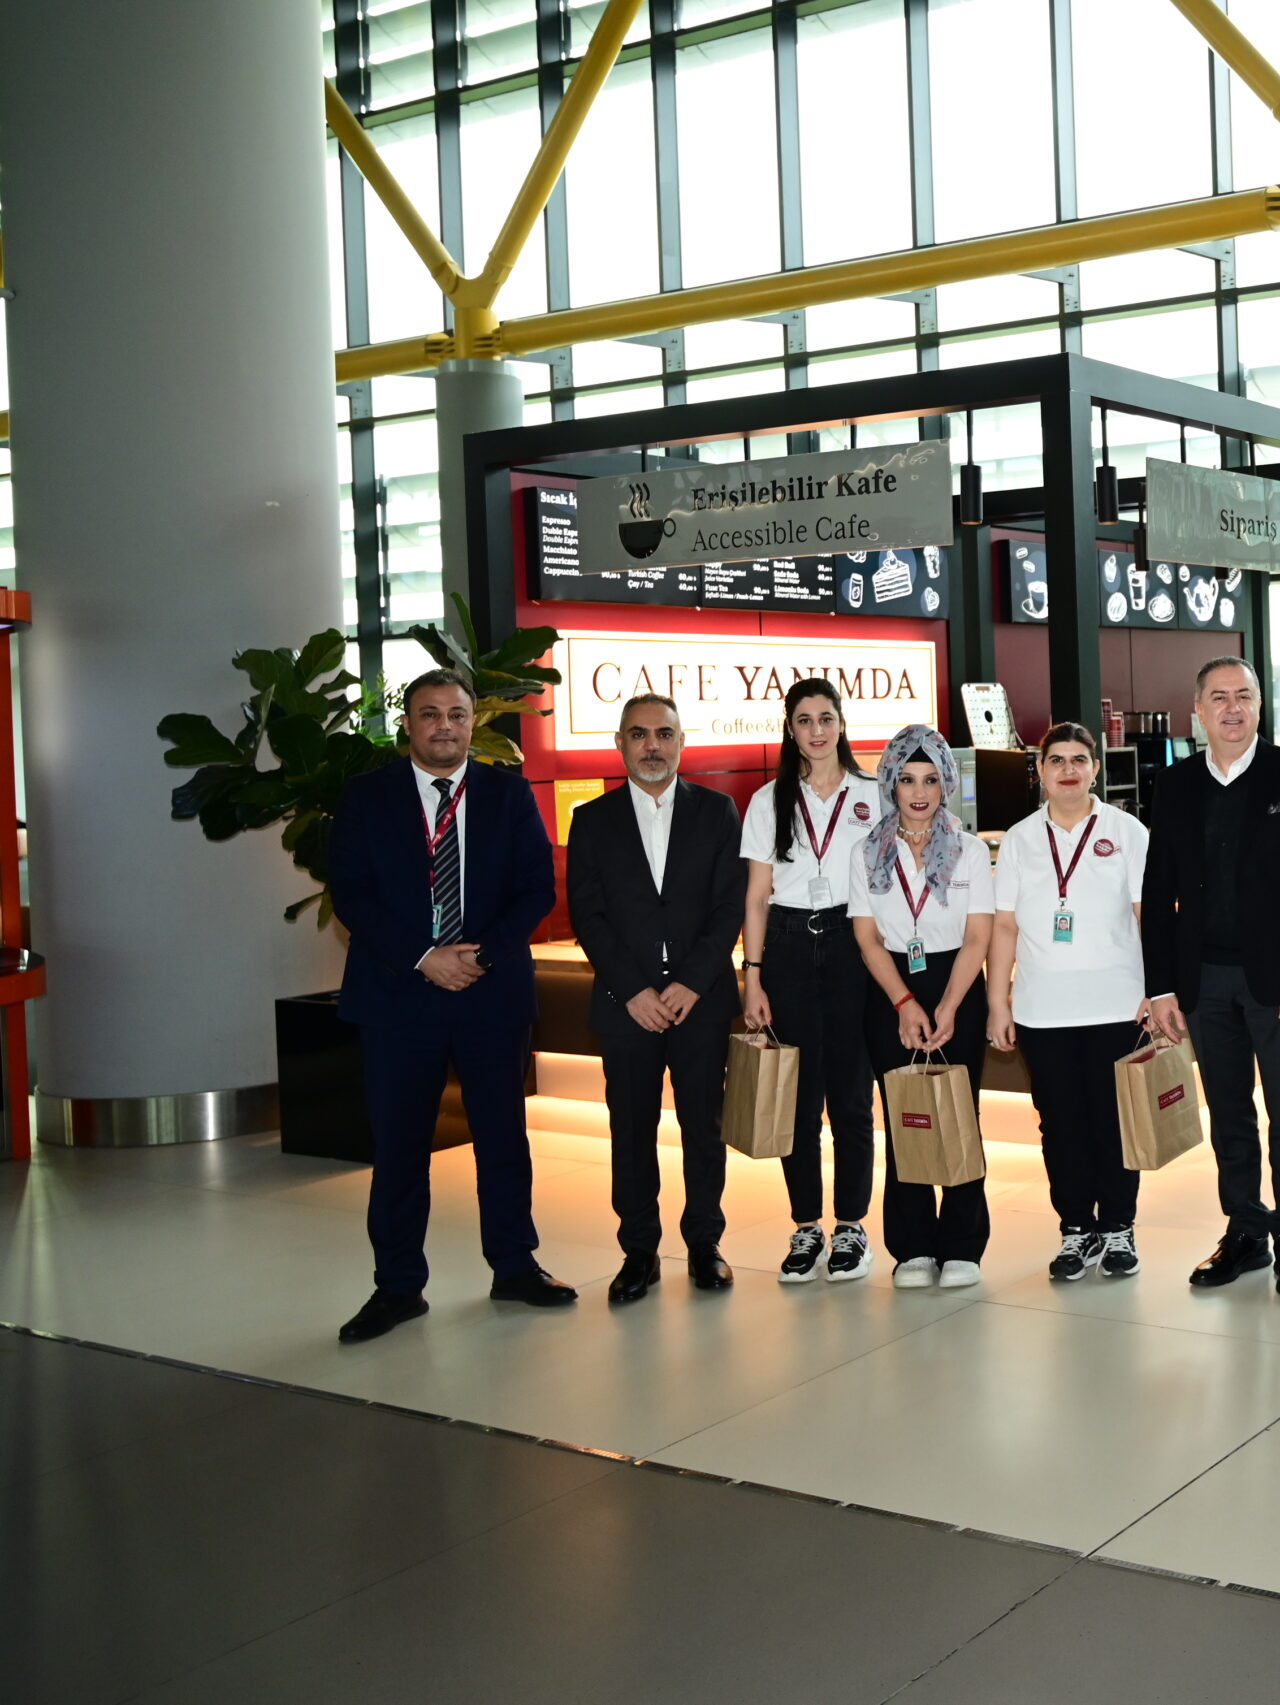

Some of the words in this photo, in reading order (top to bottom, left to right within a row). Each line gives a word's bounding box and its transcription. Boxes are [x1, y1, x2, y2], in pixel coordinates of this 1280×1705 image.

[691, 475, 829, 512] Erişilebilir
[835, 468, 898, 498] Kafe
[540, 491, 568, 506] Sıcak
[541, 515, 572, 526] Espresso
[1220, 508, 1277, 541] Sipariş
[691, 517, 808, 552] Accessible
[815, 513, 871, 542] Cafe
[542, 545, 578, 556] Macchiato
[543, 556, 580, 567] Americano
[543, 566, 583, 577] Cappuccin
[592, 662, 719, 703] CAFE
